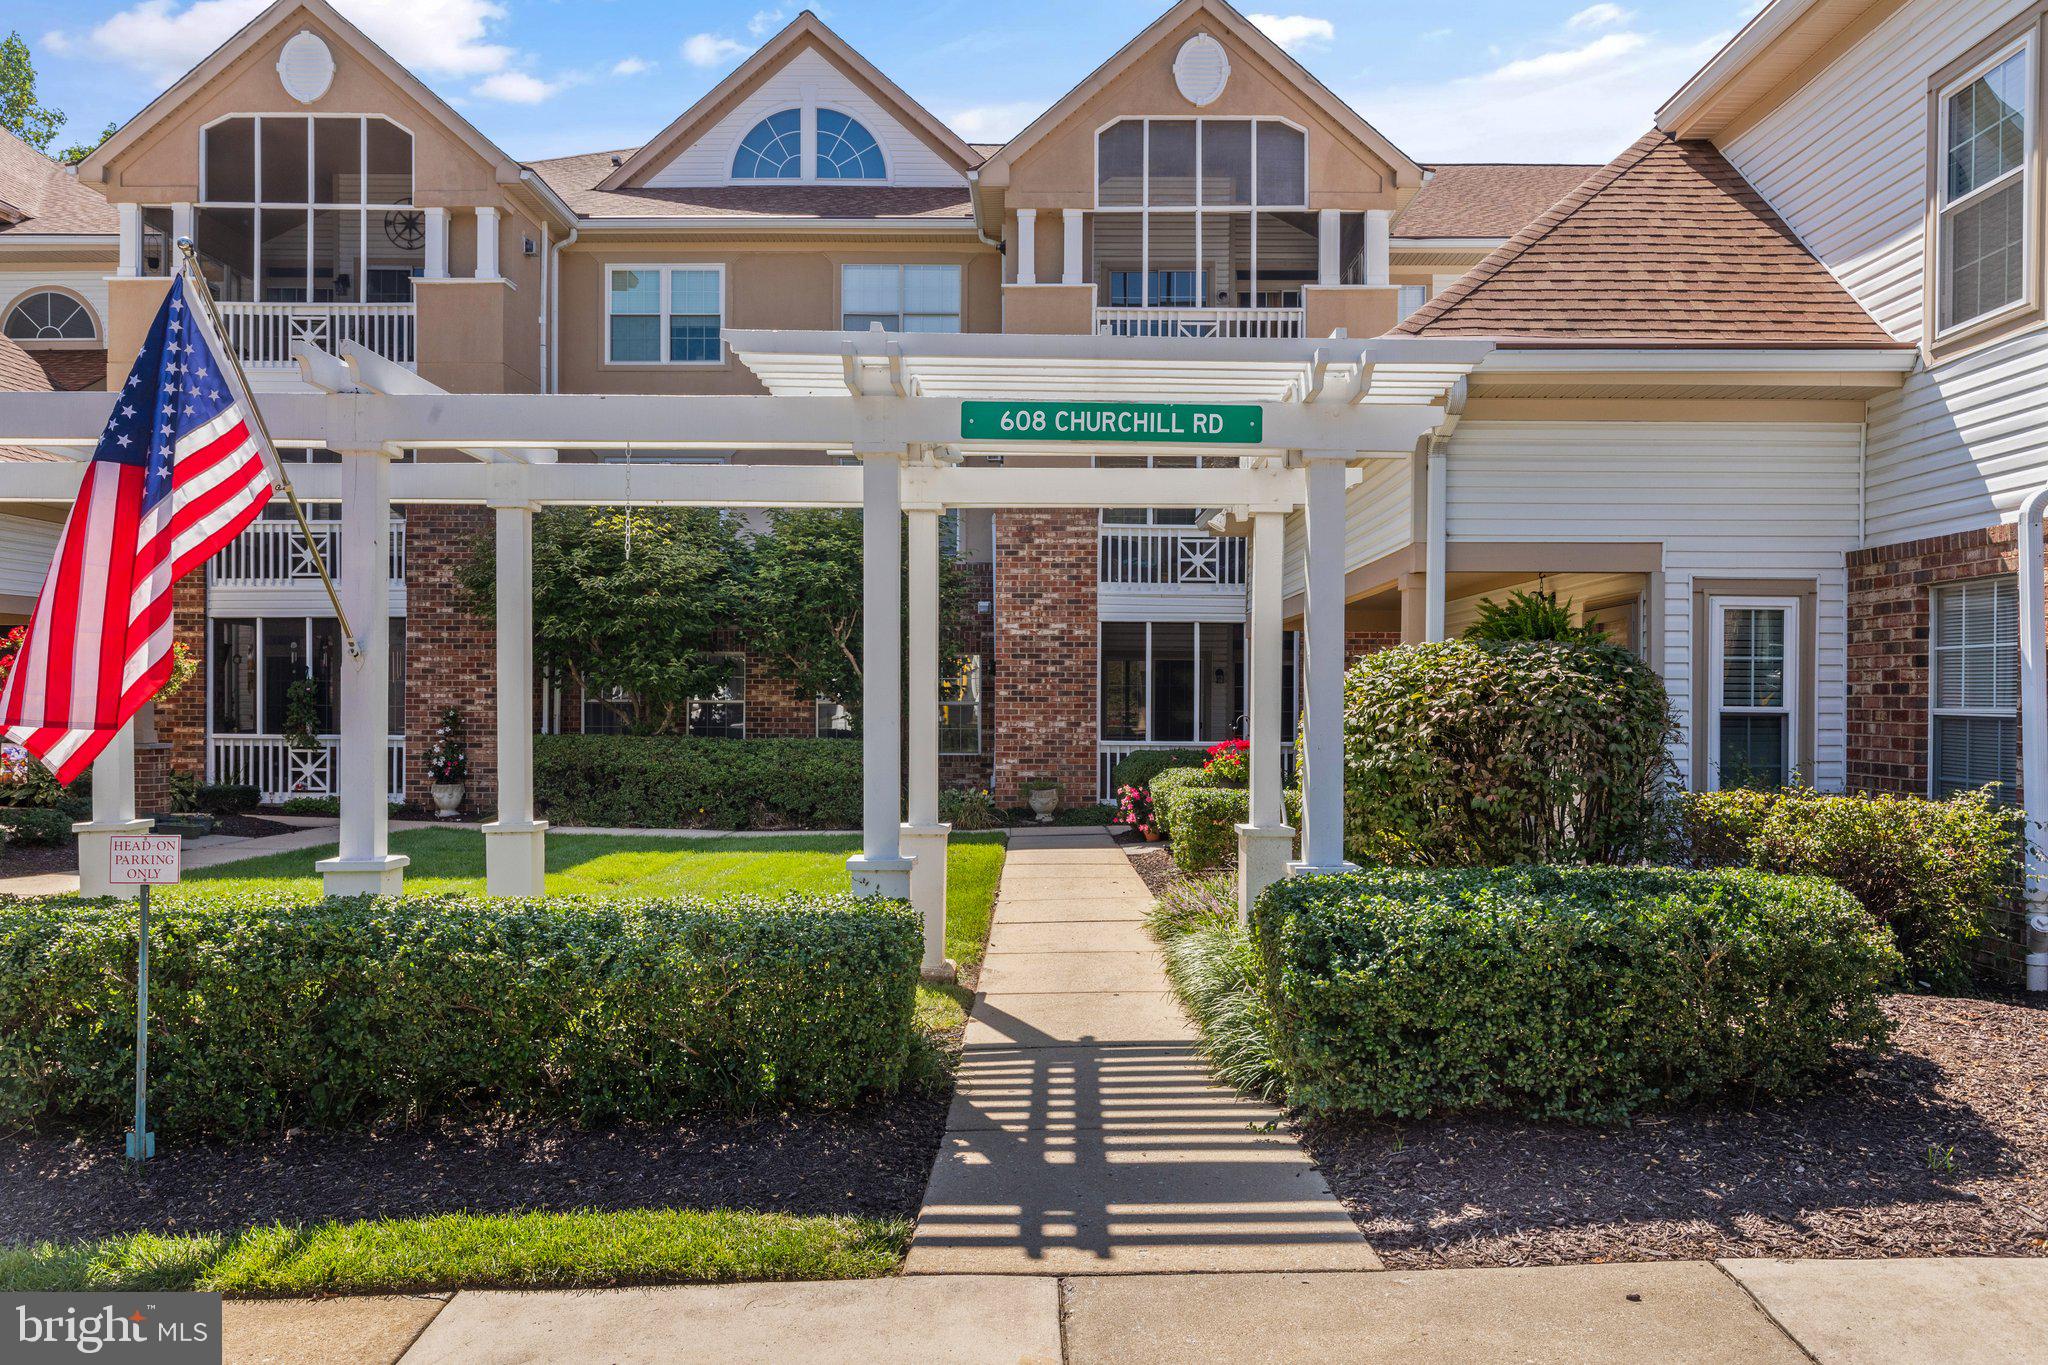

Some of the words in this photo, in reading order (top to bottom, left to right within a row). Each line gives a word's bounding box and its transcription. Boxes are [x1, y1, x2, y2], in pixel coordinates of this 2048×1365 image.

[1000, 410, 1047, 431] 608
[1055, 411, 1185, 433] CHURCHILL
[1193, 413, 1224, 434] RD
[114, 841, 176, 851] HEAD-ON
[115, 855, 174, 865] PARKING
[127, 869, 161, 879] ONLY
